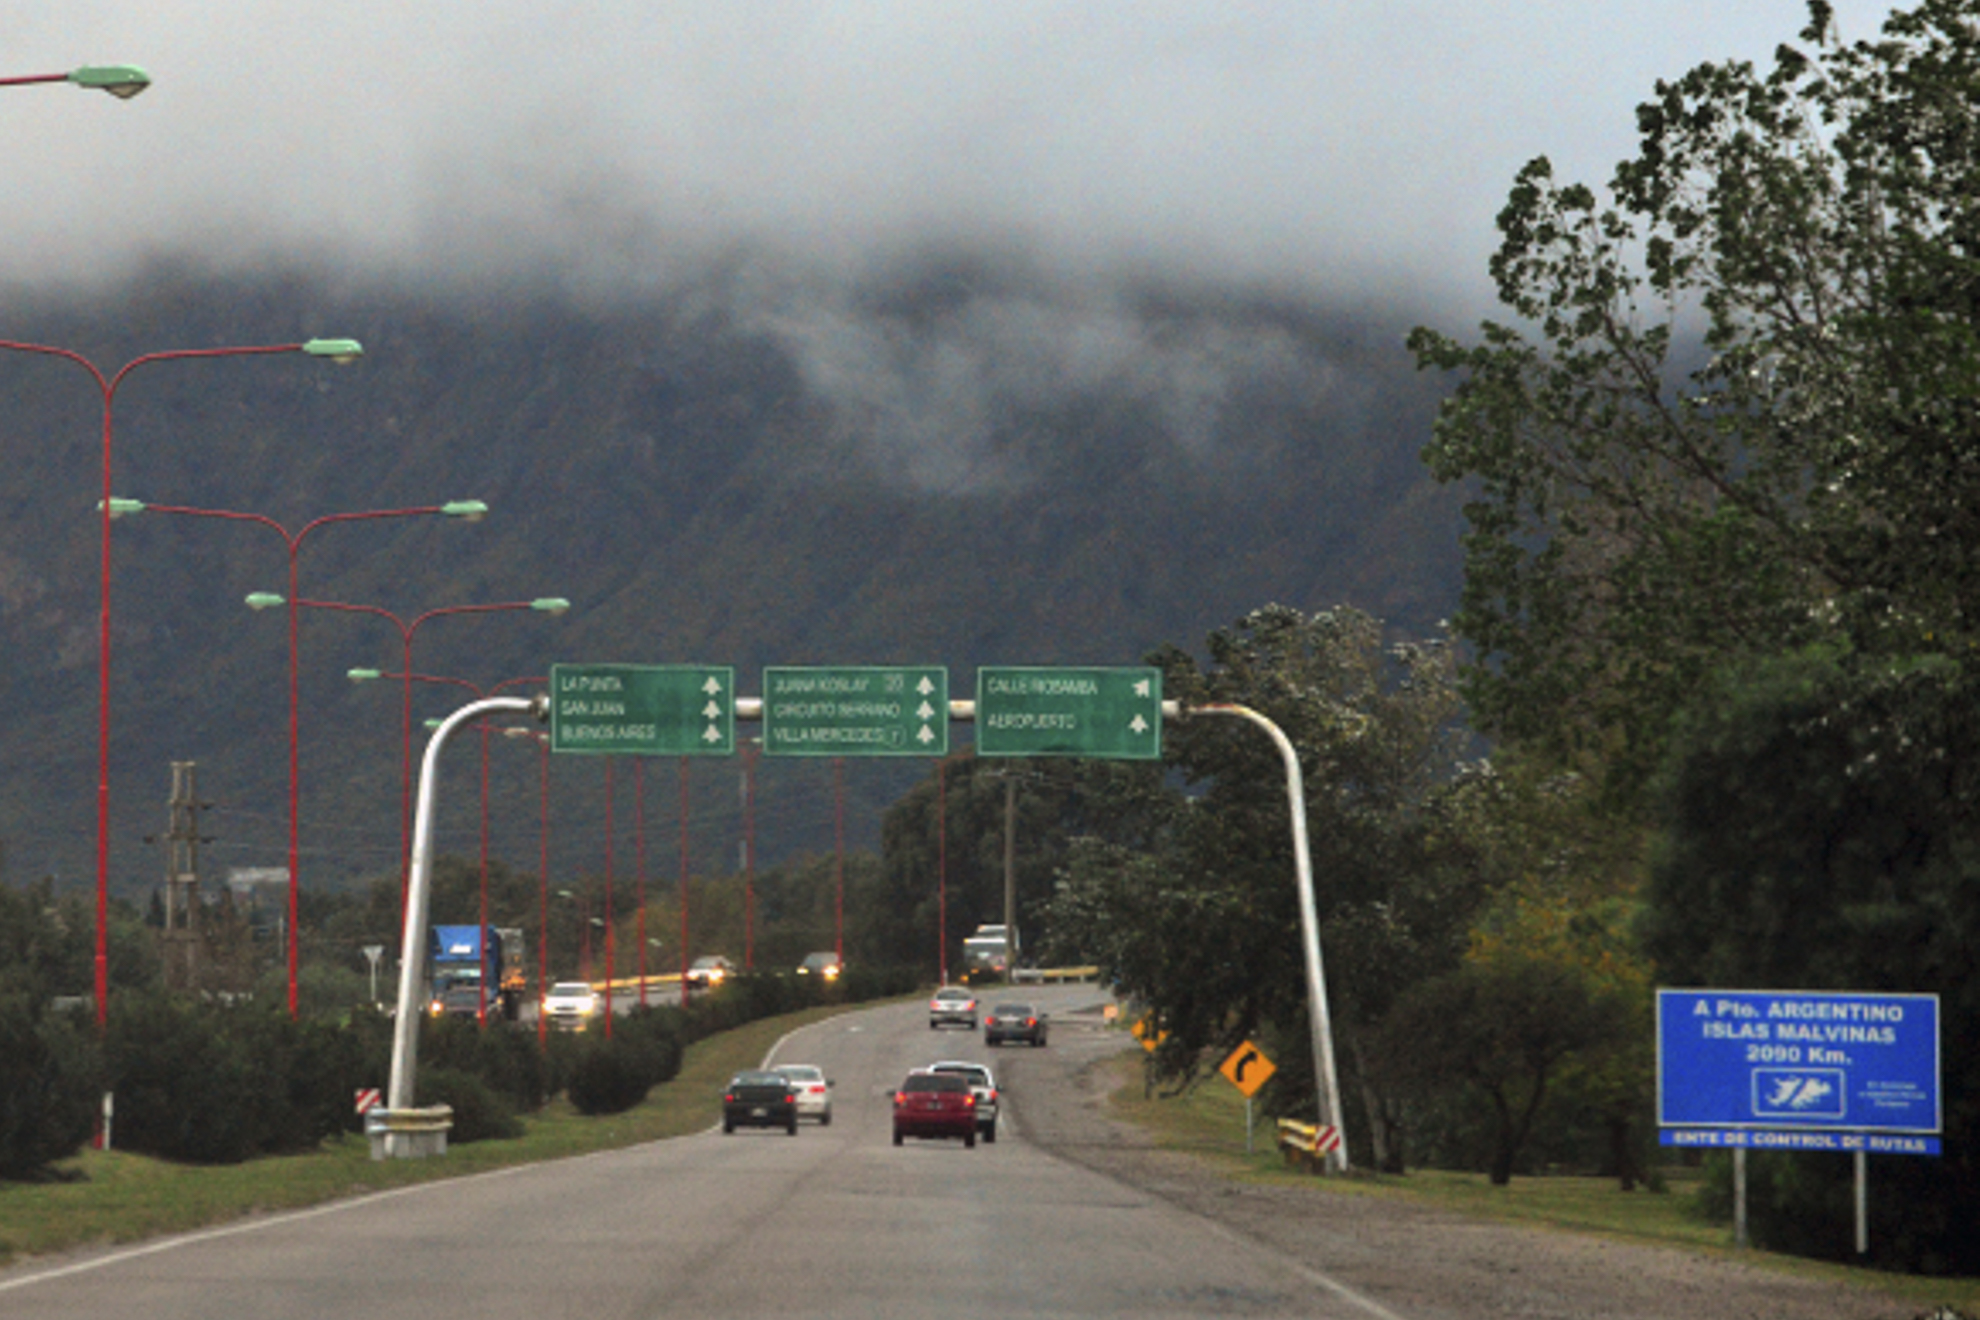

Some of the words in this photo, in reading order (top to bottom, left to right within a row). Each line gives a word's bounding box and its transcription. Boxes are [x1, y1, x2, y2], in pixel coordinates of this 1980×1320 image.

[562, 700, 588, 715] SAN
[561, 724, 615, 740] BUENOS
[616, 724, 656, 740] AIRES
[987, 714, 1076, 729] AEROPUERTO
[1693, 1000, 1710, 1017] A
[1716, 1000, 1760, 1018] Pto.
[1767, 1002, 1904, 1022] ARGENTINO
[1703, 1022, 1769, 1040] ISLAS
[1778, 1024, 1896, 1044] MALVINAS
[1746, 1044, 1801, 1063] 2090
[1808, 1047, 1853, 1065] Km.
[1673, 1131, 1720, 1145] ENTE
[1724, 1132, 1748, 1146] DE
[1752, 1133, 1837, 1149] CONTROL
[1841, 1135, 1865, 1150] DE
[1869, 1136, 1927, 1152] RUTAS
